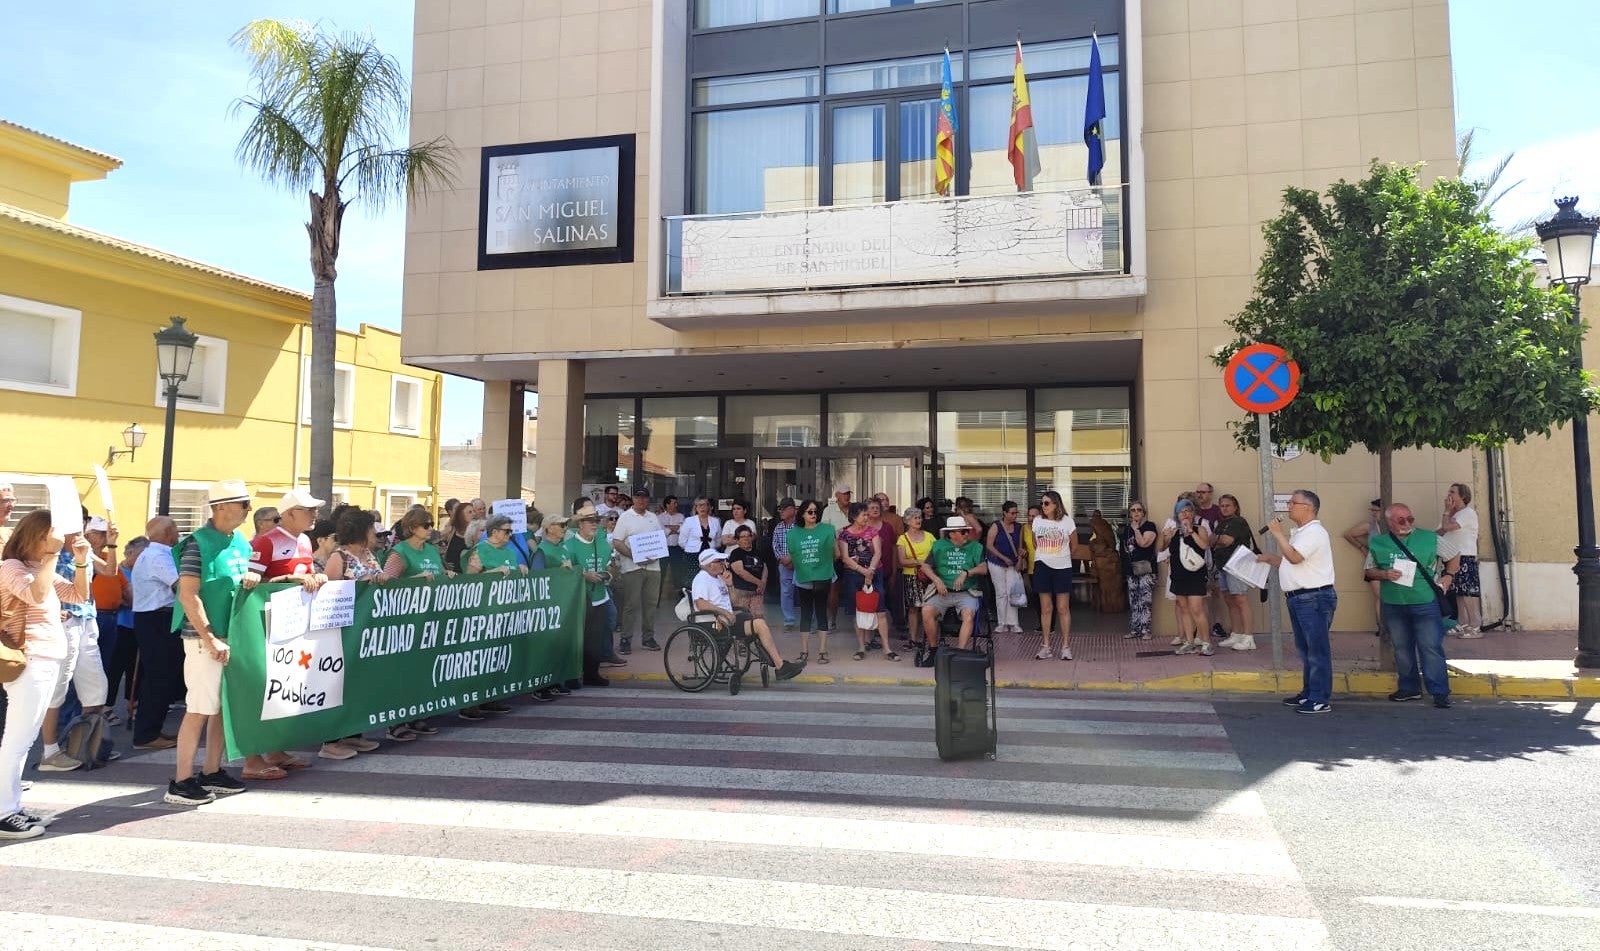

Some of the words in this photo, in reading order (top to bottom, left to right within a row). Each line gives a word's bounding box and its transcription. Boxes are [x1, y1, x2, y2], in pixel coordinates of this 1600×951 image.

[539, 200, 608, 219] MIGUEL
[534, 224, 608, 243] SALINAS
[862, 238, 889, 252] DEL
[372, 585, 430, 618] SANIDAD
[434, 582, 483, 610] 100X100
[489, 576, 529, 607] PÚBLICA
[530, 583, 538, 601] Y
[539, 577, 550, 600] DE
[360, 623, 414, 659] CALIDAD
[420, 619, 439, 650] EN
[444, 616, 458, 646] EL
[460, 611, 546, 644] DEPARTAMENTO
[547, 608, 561, 630] 22
[272, 647, 294, 665] 100
[319, 656, 343, 673] 100
[432, 643, 513, 688] (TORREVIEJA)
[268, 675, 326, 707] Pública
[369, 695, 457, 725] DEROGACIÓN
[463, 690, 479, 703] DE
[486, 688, 498, 698] LA
[503, 682, 523, 694] LEY
